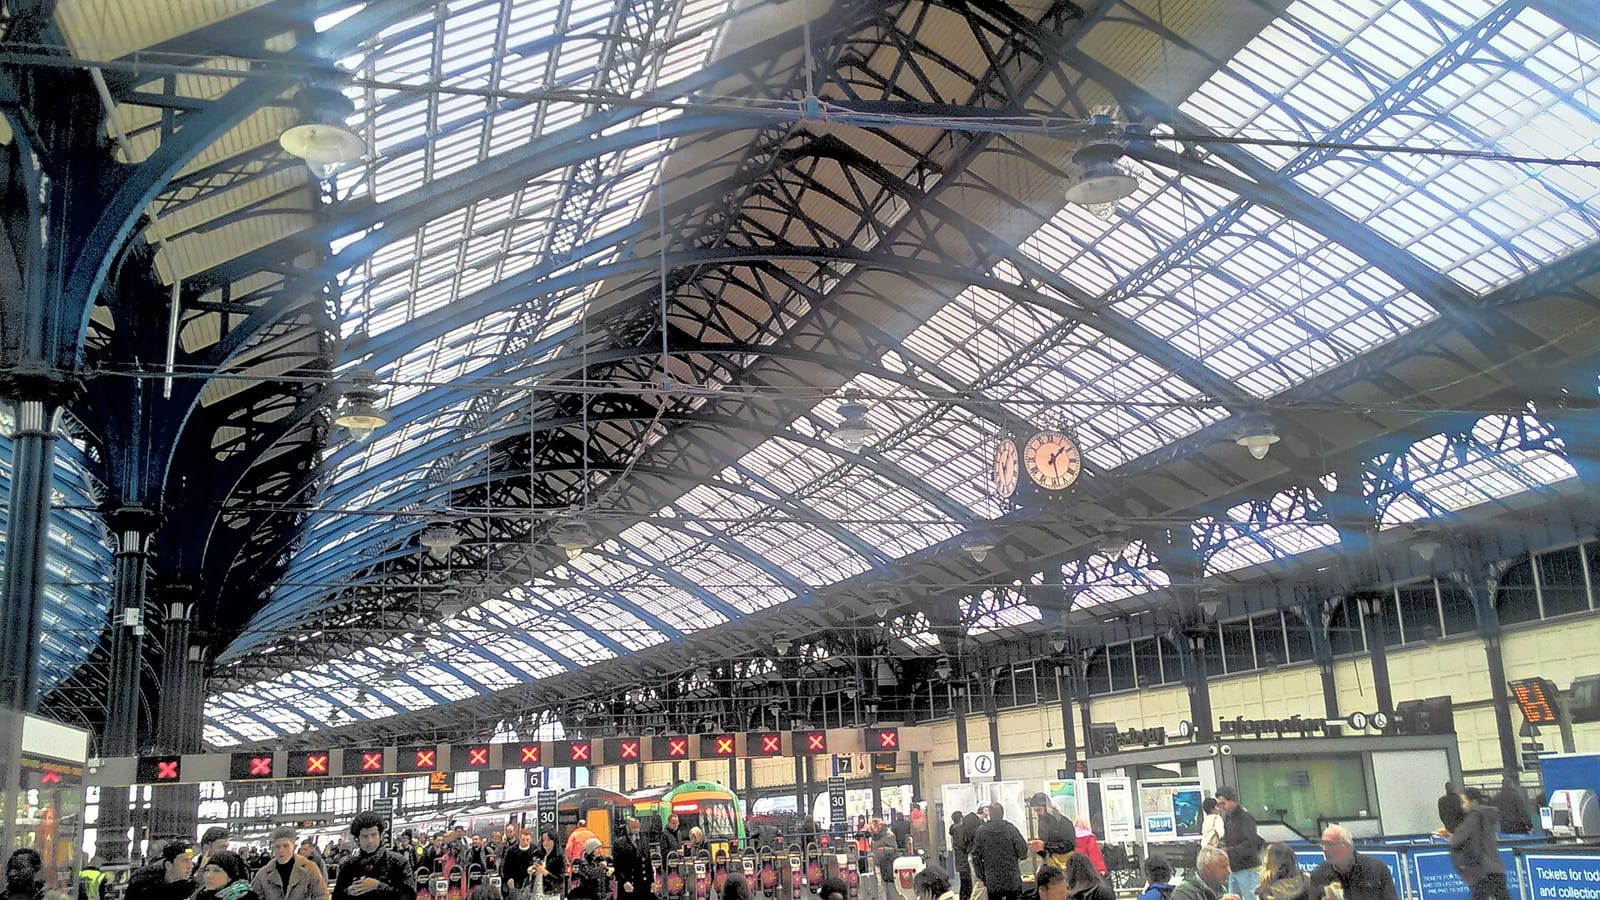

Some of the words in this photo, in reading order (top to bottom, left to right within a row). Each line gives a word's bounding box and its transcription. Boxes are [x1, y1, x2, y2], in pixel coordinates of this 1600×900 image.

[841, 760, 848, 771] 7
[530, 773, 538, 786] 6
[391, 782, 399, 795] 5
[832, 796, 844, 807] 30
[540, 811, 555, 823] 30
[1536, 867, 1568, 881] Tickets
[1569, 868, 1582, 881] for
[1540, 886, 1557, 897] and
